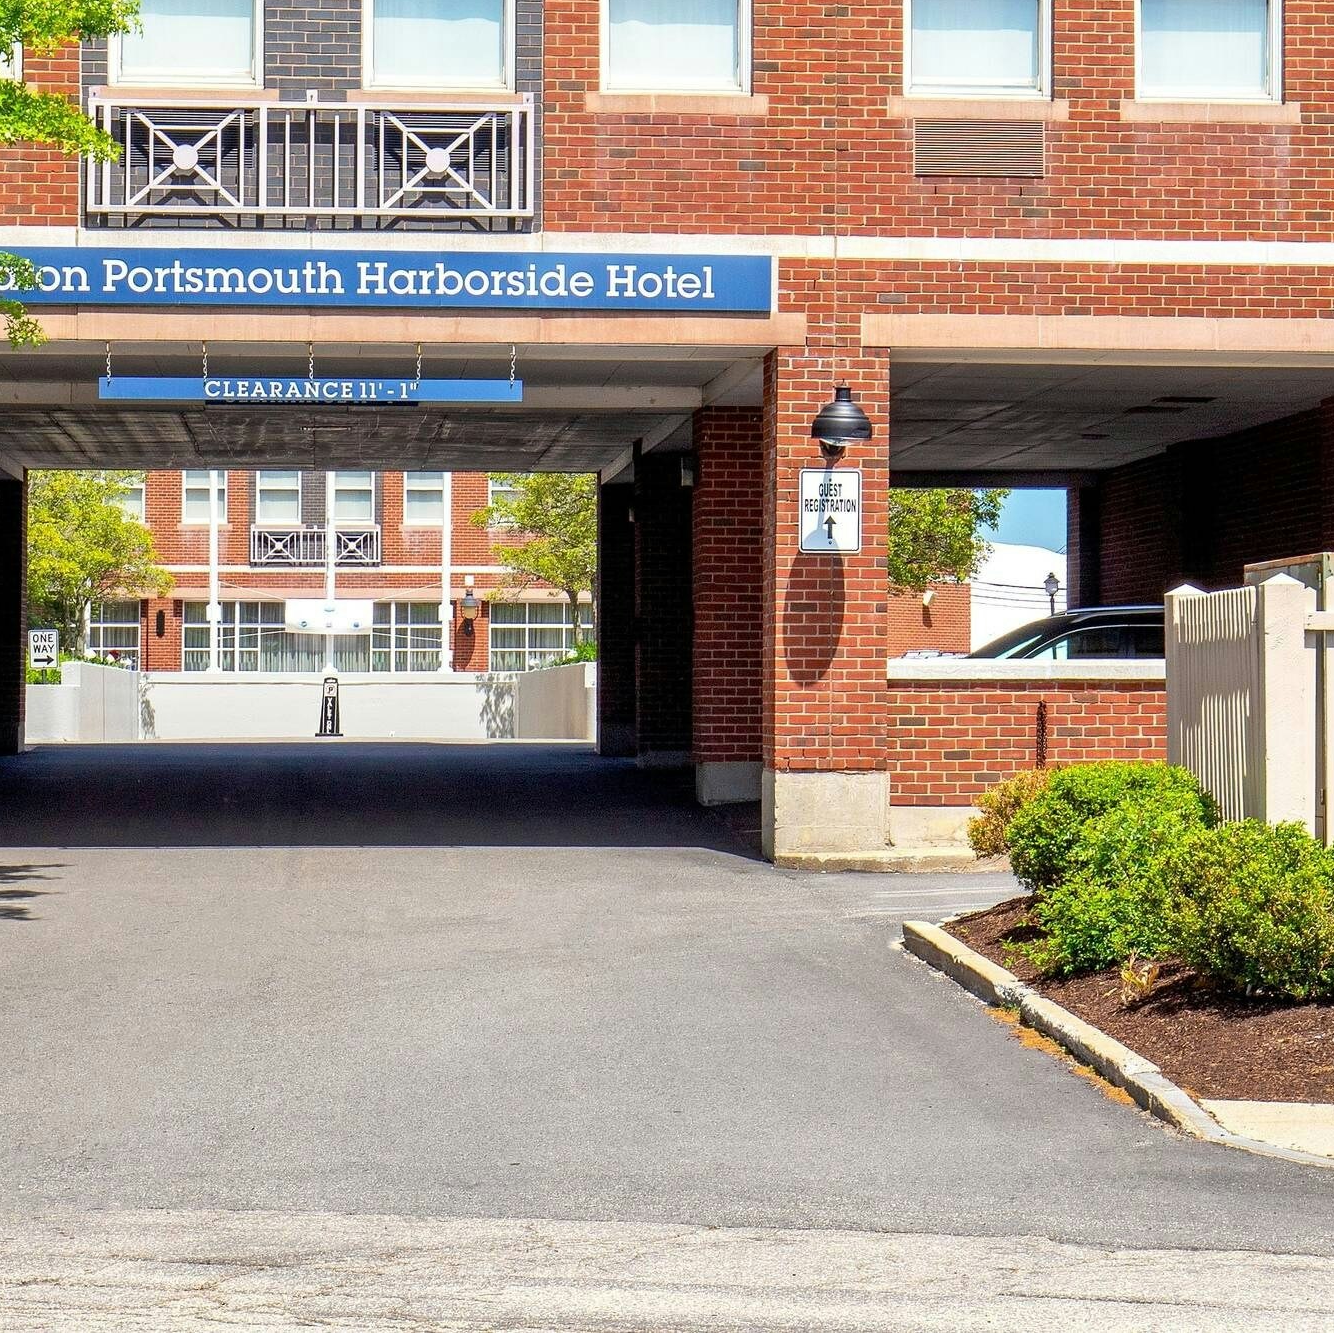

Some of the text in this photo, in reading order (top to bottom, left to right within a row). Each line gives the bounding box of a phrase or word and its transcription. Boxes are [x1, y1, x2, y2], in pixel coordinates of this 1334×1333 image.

[102, 259, 345, 294] Portsmouth
[357, 262, 593, 296] Harborside
[605, 265, 715, 298] Hotel
[204, 380, 353, 398] CLEARANCE
[359, 382, 382, 399] 11'
[818, 483, 842, 497] GUEST
[804, 499, 856, 513] REGISTRATION
[32, 633, 54, 643] ONE
[33, 645, 55, 654] WAY
